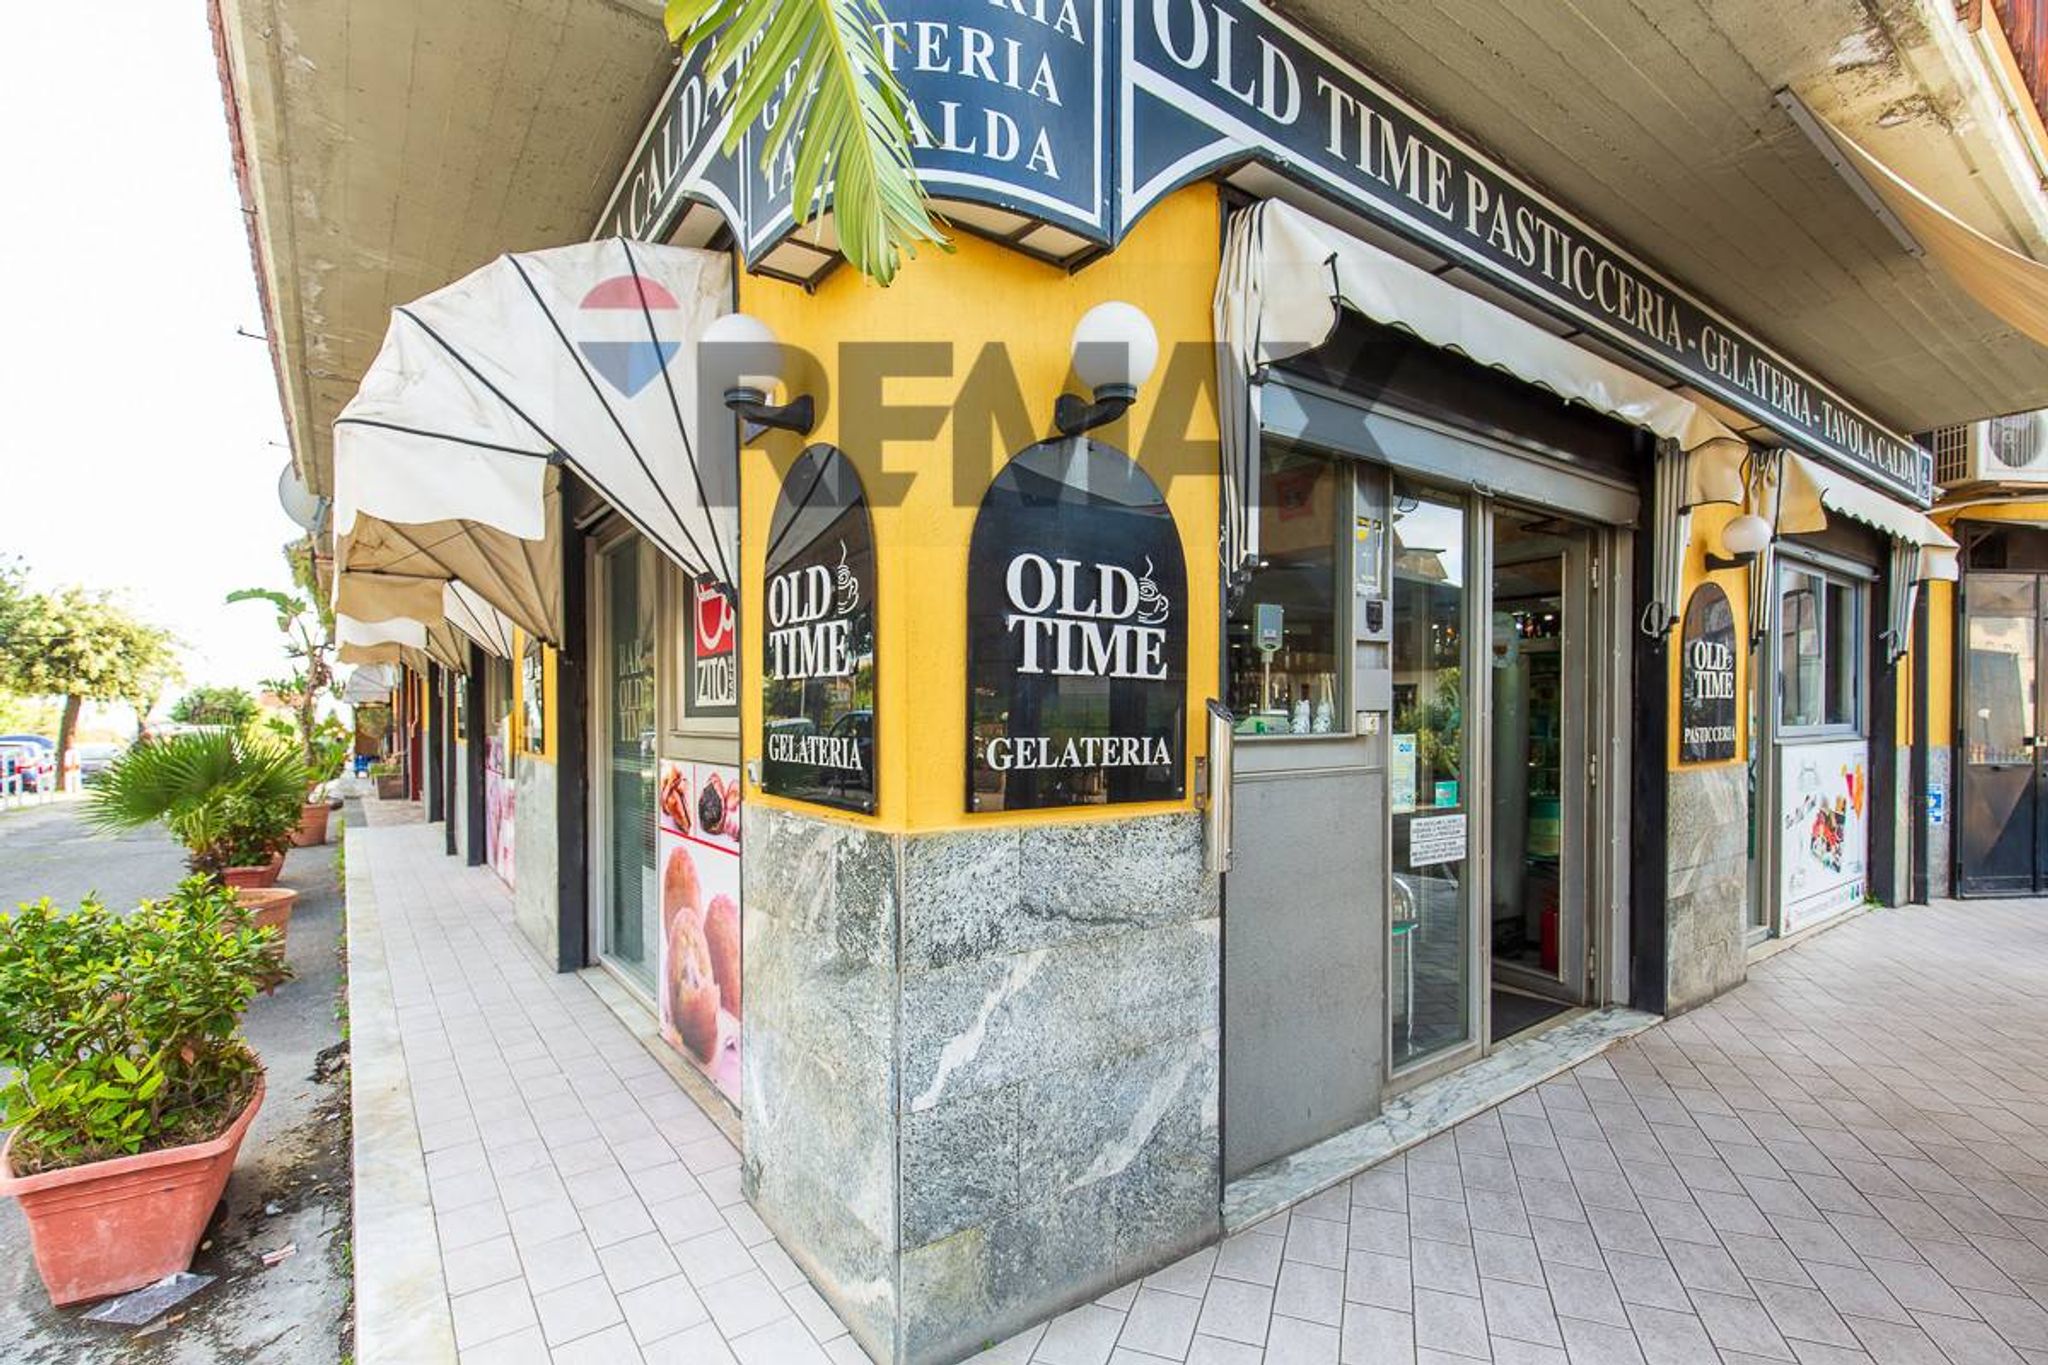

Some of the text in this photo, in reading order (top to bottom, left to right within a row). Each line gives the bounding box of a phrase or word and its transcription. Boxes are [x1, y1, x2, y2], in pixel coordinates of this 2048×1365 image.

[1152, 0, 1301, 126] OLD
[1316, 76, 1454, 221] TIME
[1463, 169, 1684, 352] PASTICCERIA
[1701, 325, 1812, 428] GELATERIA
[1822, 400, 1876, 462] TAVOLA
[1876, 436, 1917, 486] CALDA
[769, 564, 832, 628] OLD
[1006, 552, 1140, 620] OLD
[770, 618, 852, 681] TIME
[1007, 614, 1168, 681] TIME
[1694, 641, 1729, 671] OLD
[698, 657, 728, 702] ZITO
[1694, 670, 1735, 699] TIME
[768, 733, 863, 771] GELATERIA
[986, 736, 1172, 771] GELATERIA
